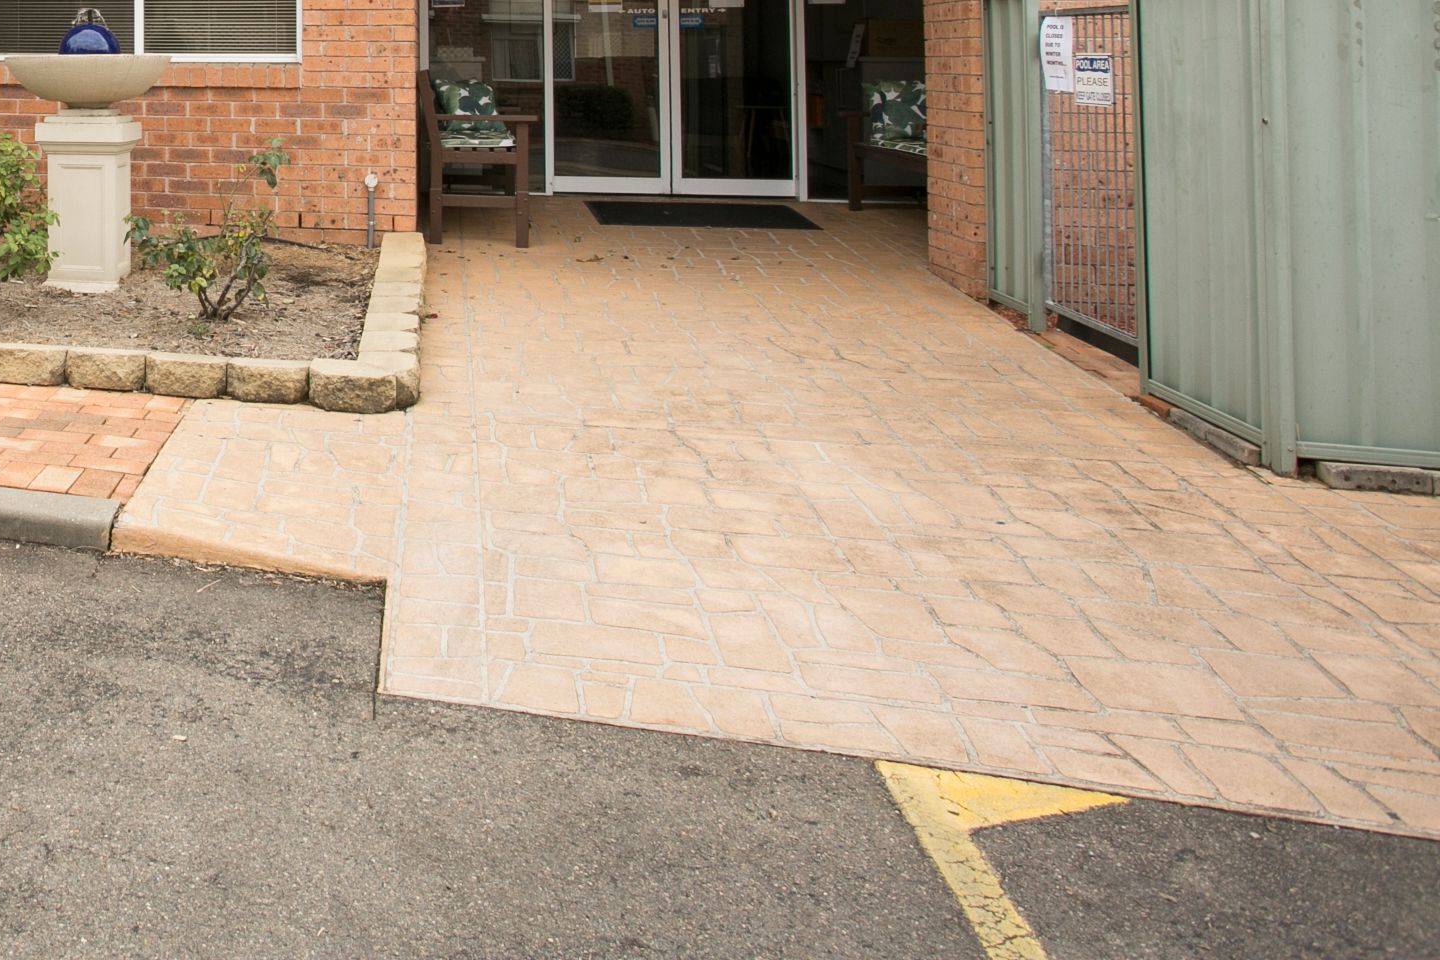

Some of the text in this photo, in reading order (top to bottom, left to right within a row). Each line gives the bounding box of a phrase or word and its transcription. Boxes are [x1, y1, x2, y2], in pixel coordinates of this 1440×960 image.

[1076, 59, 1110, 71] POOL AREA
[1077, 76, 1109, 87] PLEASE
